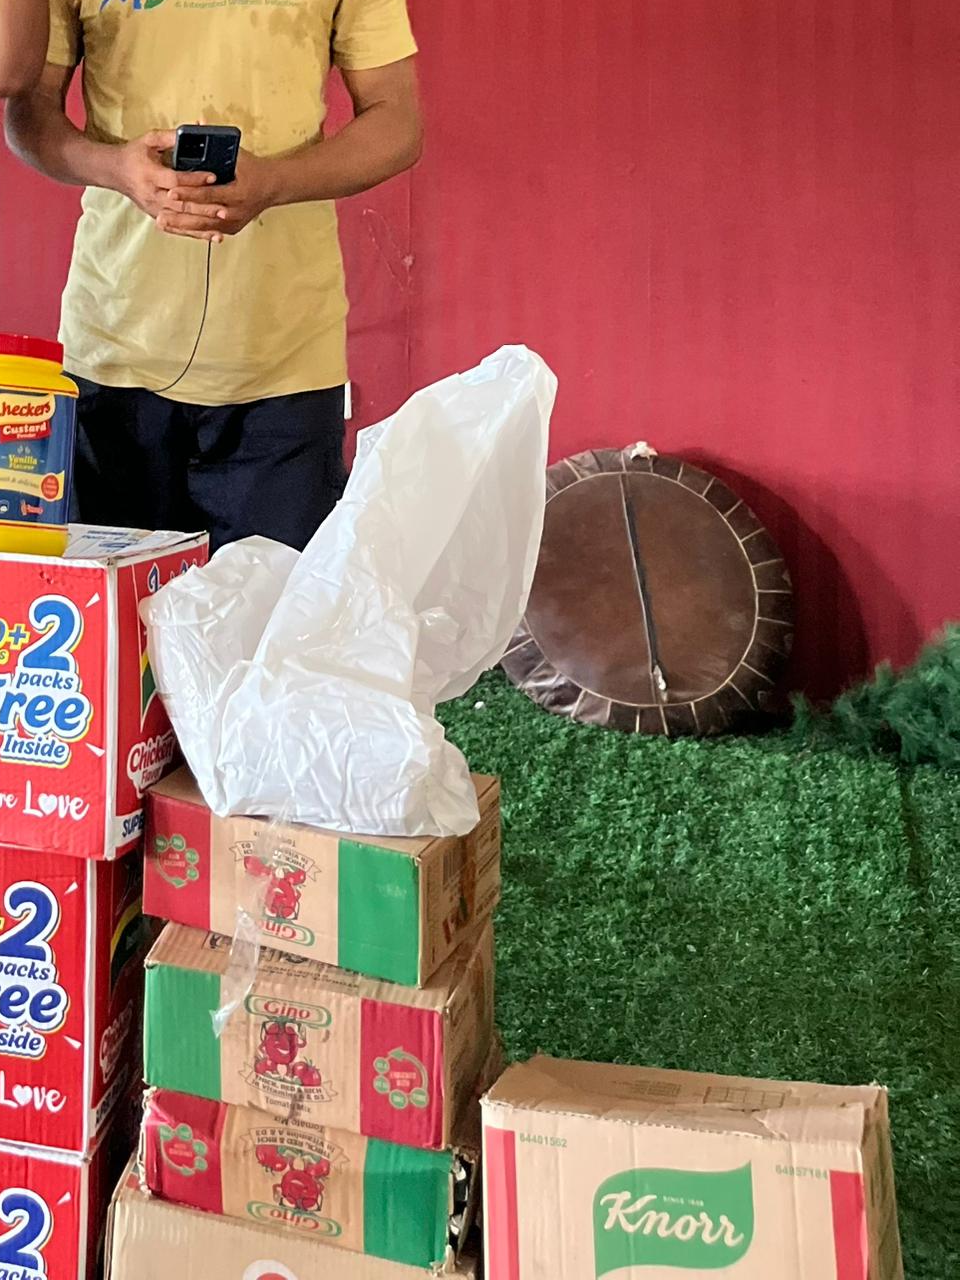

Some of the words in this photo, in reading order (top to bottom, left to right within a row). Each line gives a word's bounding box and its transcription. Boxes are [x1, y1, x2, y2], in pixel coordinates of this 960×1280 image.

[2, 421, 47, 435] Custard
[8, 453, 38, 468] Vanilla
[21, 599, 76, 672] 2
[15, 672, 74, 690] packs
[2, 733, 67, 759] Inside
[263, 999, 311, 1020] Gino
[291, 1118, 325, 1134] Tomato
[269, 1207, 320, 1231] Gino
[599, 1190, 745, 1248] Knorr
